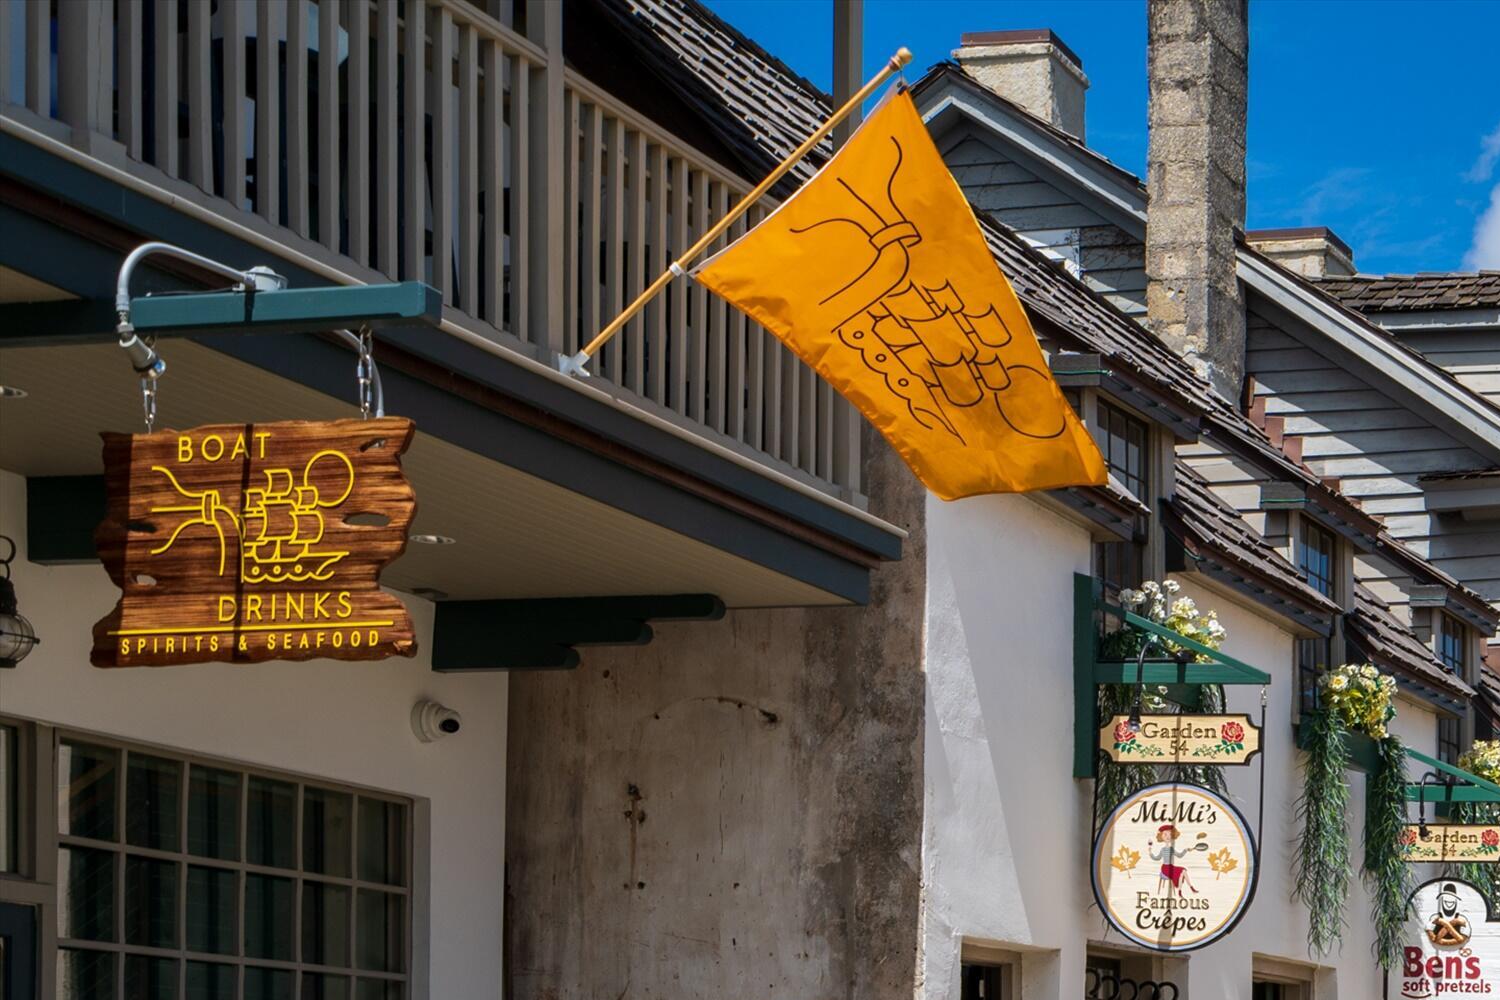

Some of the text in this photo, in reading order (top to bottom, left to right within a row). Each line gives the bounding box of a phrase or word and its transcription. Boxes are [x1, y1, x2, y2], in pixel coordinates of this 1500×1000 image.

[178, 433, 271, 462] BOAT
[218, 592, 352, 623] DRINKS
[121, 630, 380, 654] SPIRITS & SEAFOOD
[1142, 722, 1217, 740] Garden
[1169, 740, 1189, 756] 54
[1135, 891, 1210, 910] Famous
[1135, 908, 1207, 937] Crêpes
[1402, 978, 1492, 997] soft pretzels
